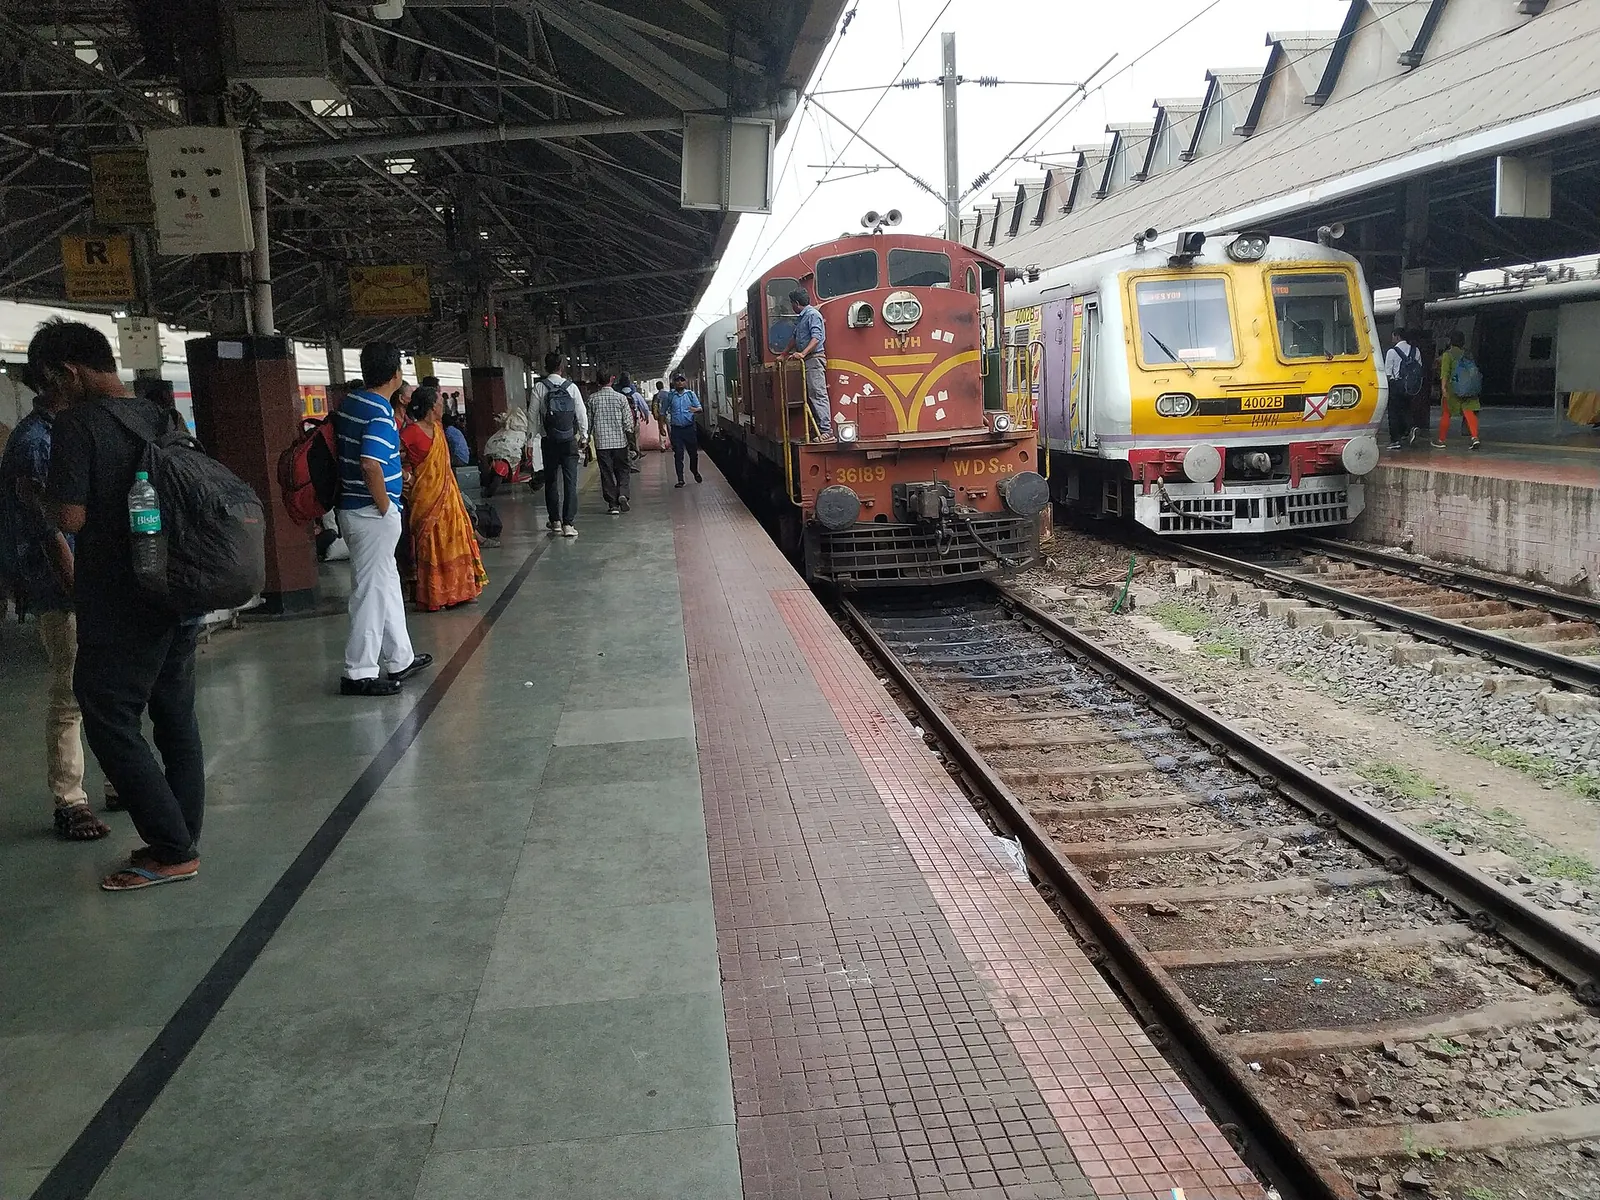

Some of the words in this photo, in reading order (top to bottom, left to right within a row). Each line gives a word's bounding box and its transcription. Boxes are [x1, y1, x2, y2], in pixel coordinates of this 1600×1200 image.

[85, 241, 109, 264] R
[884, 336, 921, 349] HWH
[1244, 397, 1283, 408] 4002B
[836, 466, 887, 483] 36189
